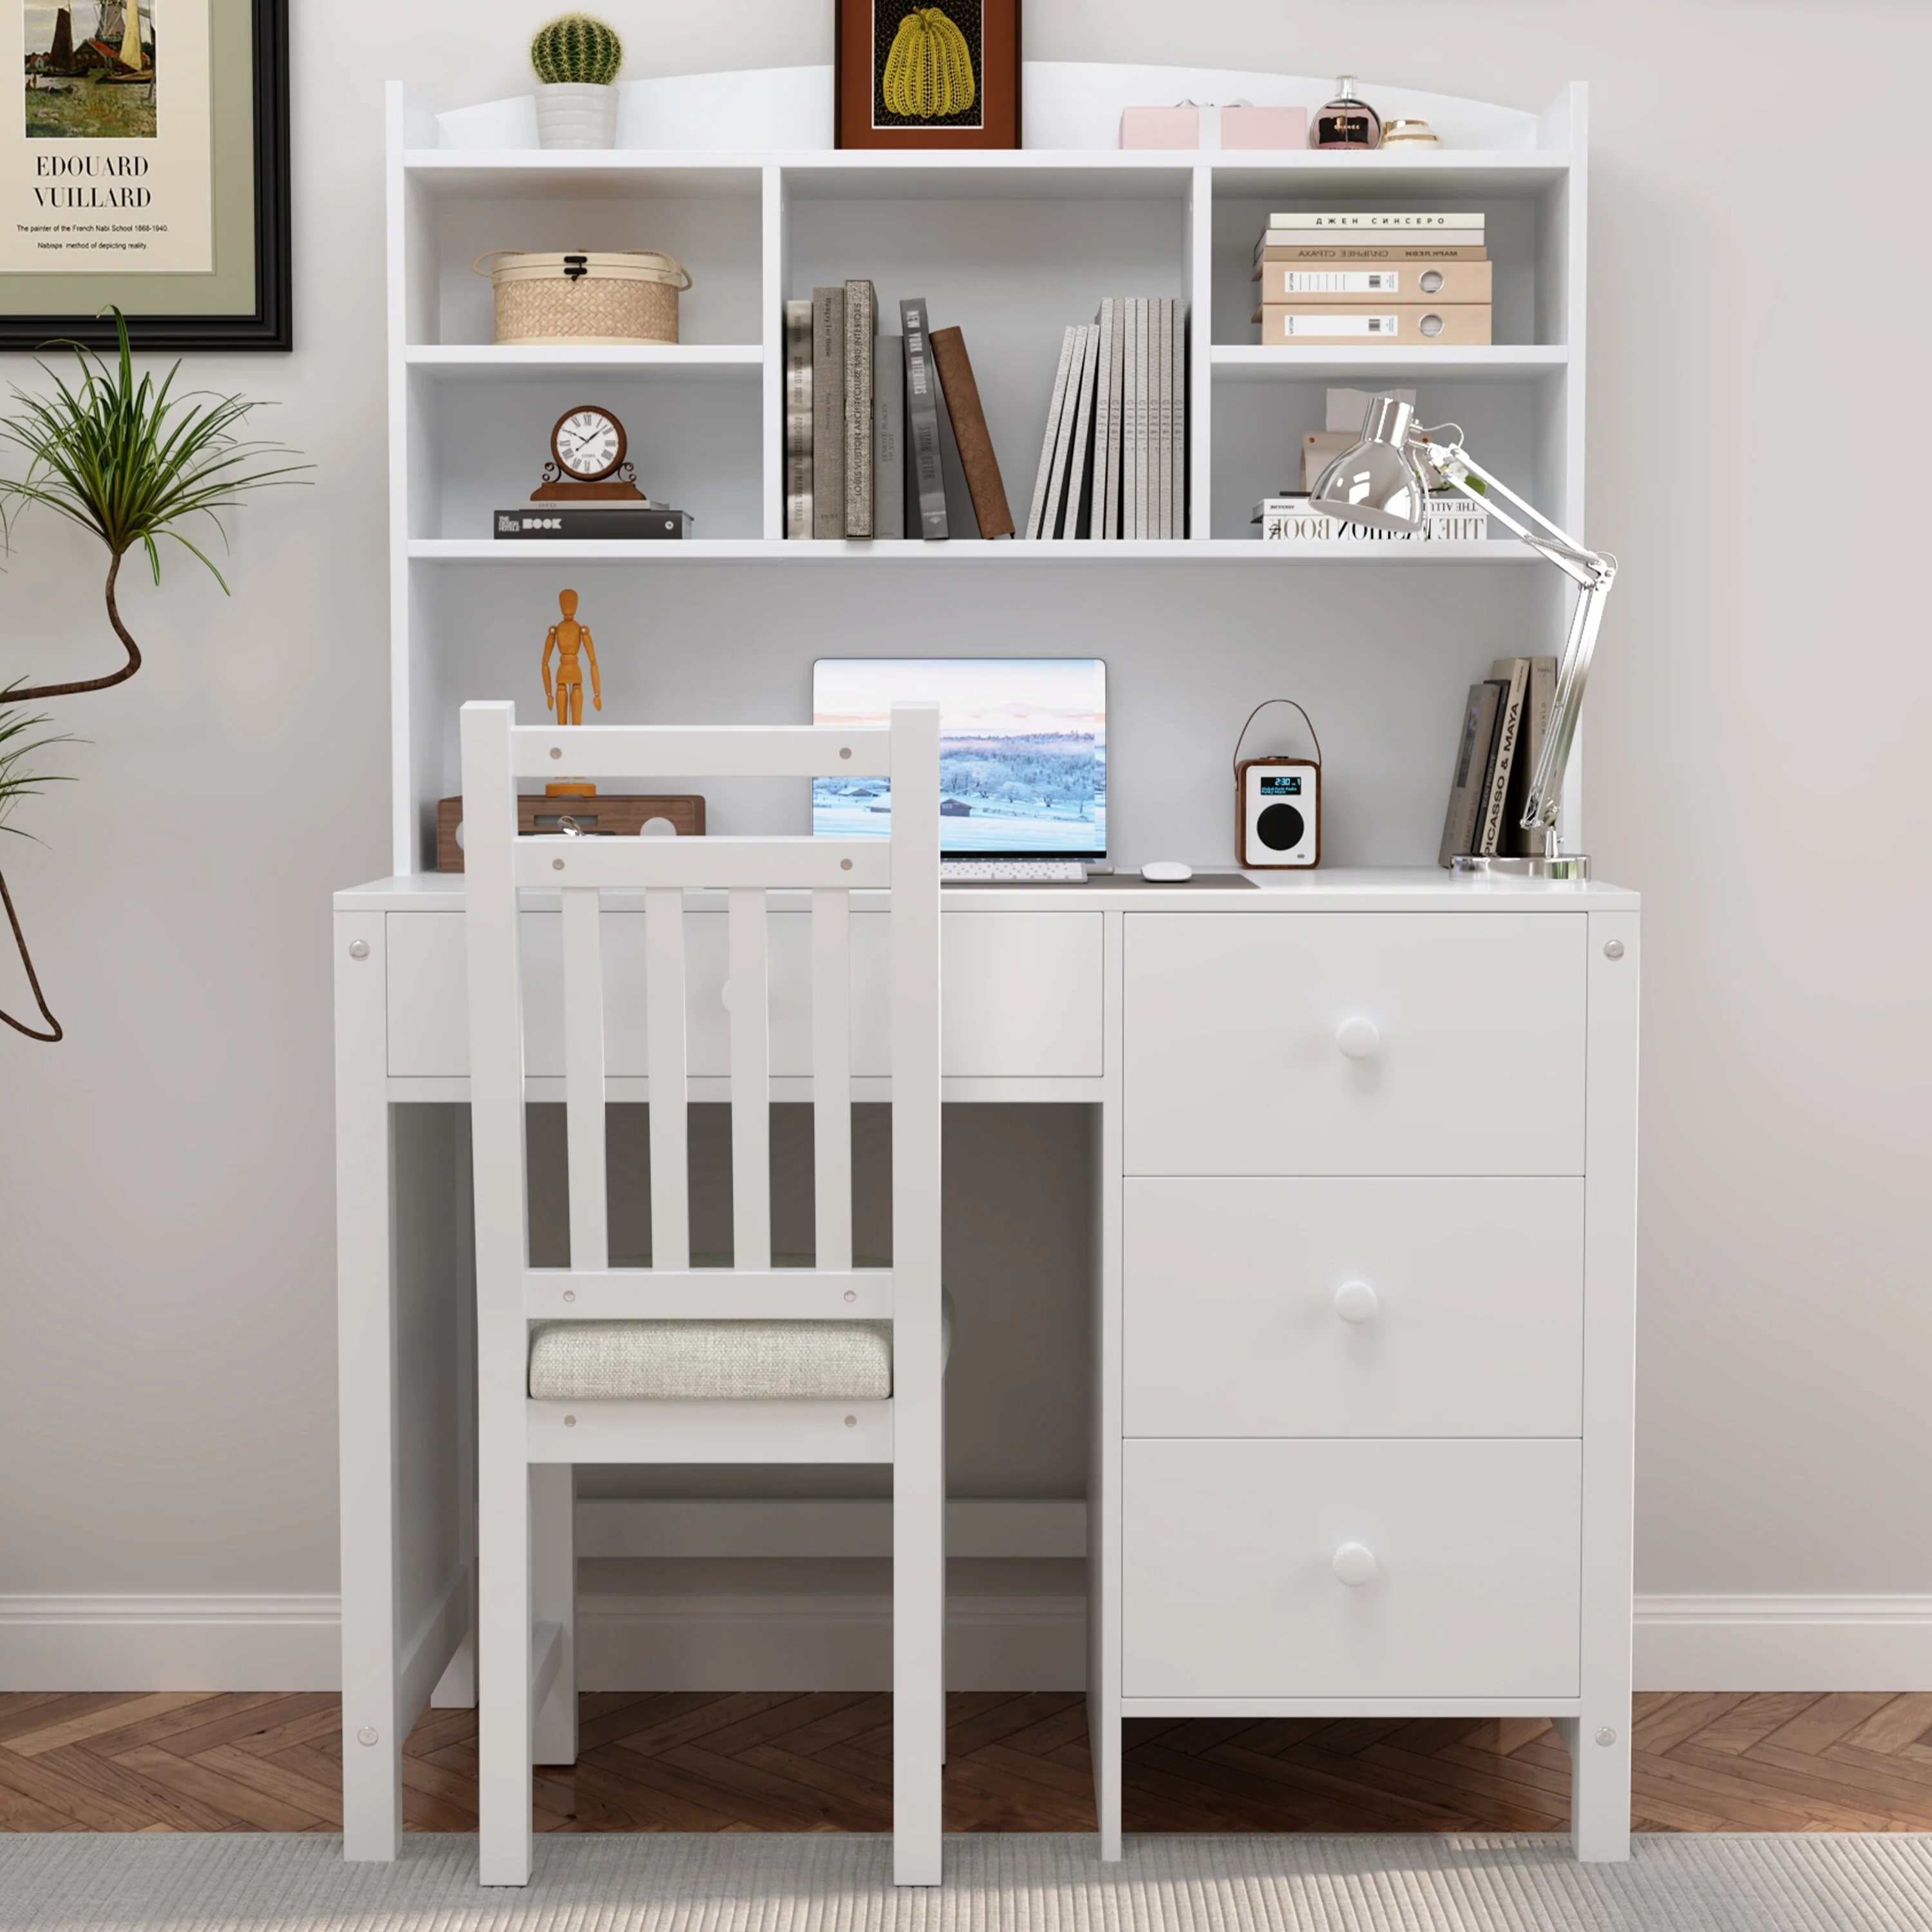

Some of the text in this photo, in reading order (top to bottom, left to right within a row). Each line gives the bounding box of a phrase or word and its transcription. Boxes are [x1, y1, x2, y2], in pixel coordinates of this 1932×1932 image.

[35, 155, 149, 176] EDOUARD
[32, 187, 151, 208] VUILLARD
[30, 224, 52, 233] painter
[98, 242, 126, 250] depicting
[128, 242, 149, 250] reality.
[906, 310, 927, 395] NEW YORK INTERIORS
[794, 386, 802, 404] JUDD
[1423, 502, 1478, 512] THE ALLU
[522, 518, 562, 529] BOOK
[1504, 703, 1519, 752] MAYA
[1501, 757, 1508, 770] &
[1484, 775, 1505, 856] PICASSO
